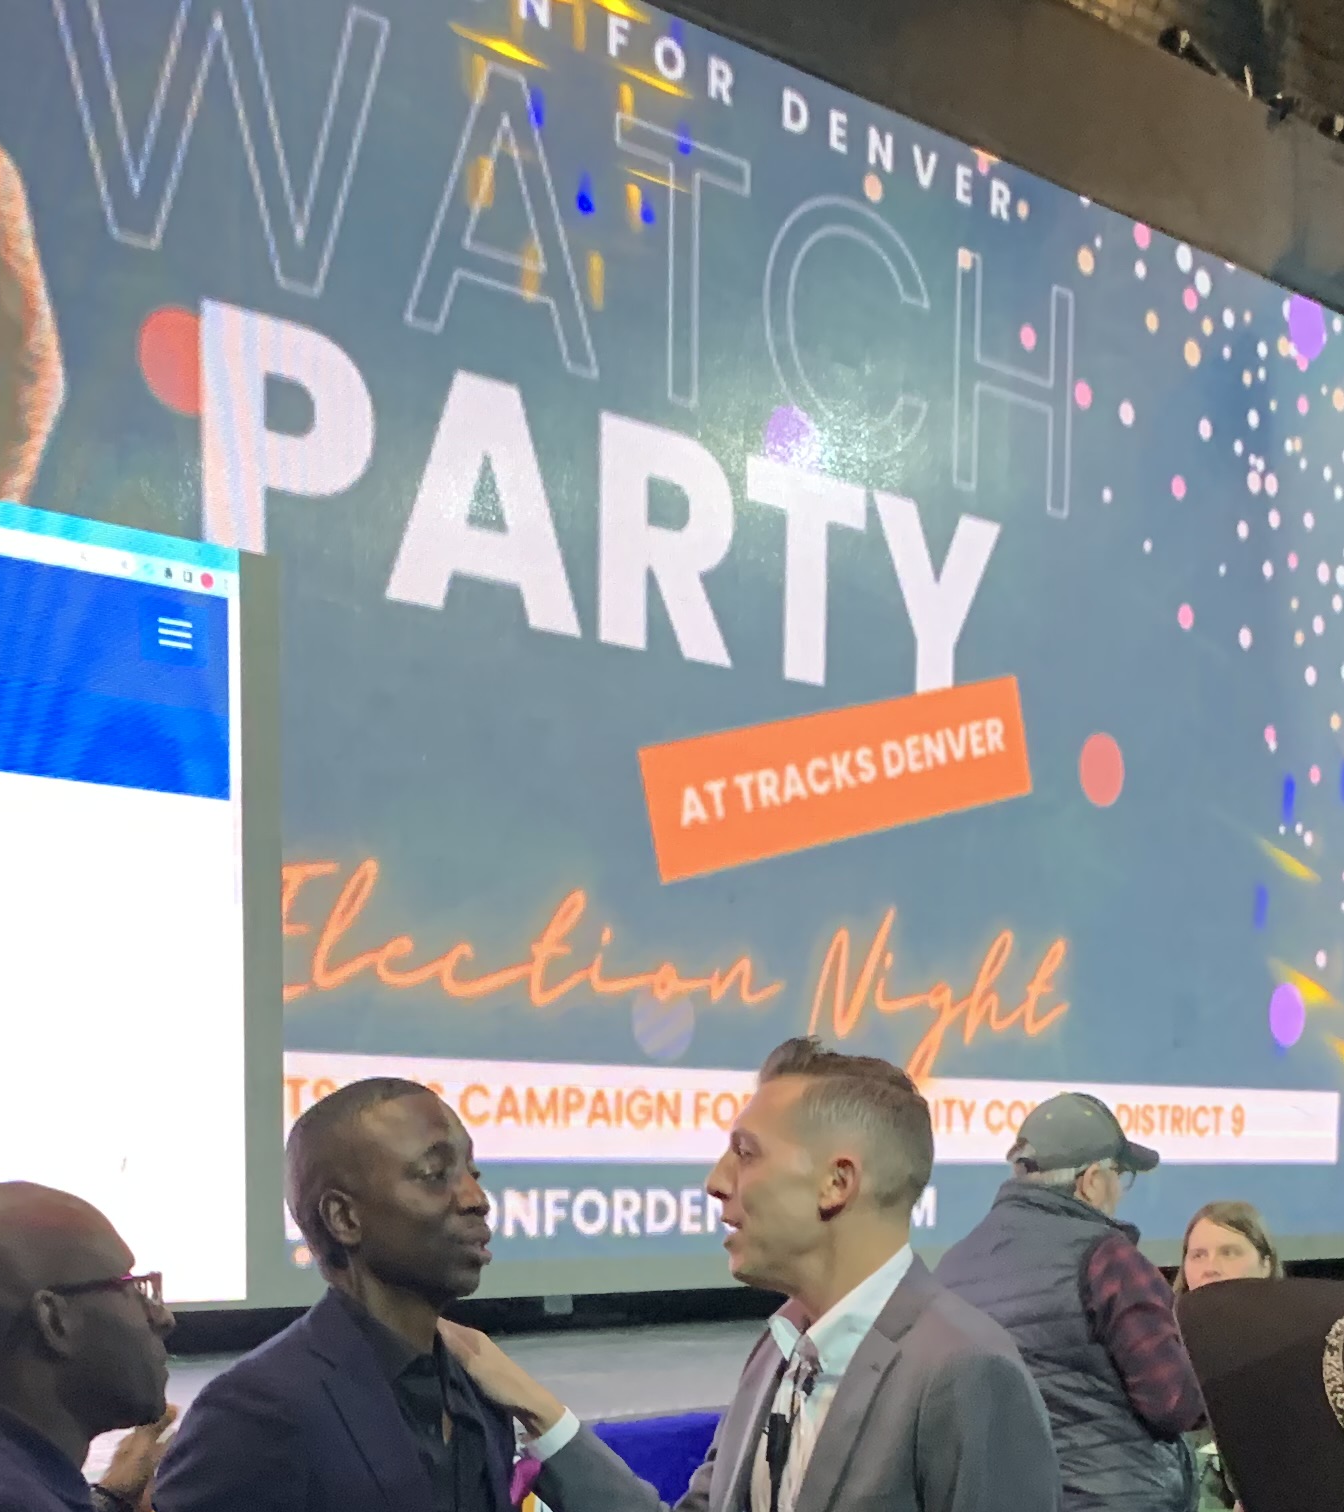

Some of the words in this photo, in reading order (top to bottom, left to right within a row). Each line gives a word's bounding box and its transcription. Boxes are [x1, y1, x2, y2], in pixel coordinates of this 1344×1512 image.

[607, 17, 735, 108] FOR
[781, 87, 1014, 224] DENVER
[53, 0, 1076, 520] WATCH
[197, 298, 1002, 694] PARTY
[678, 778, 726, 829] AT
[733, 747, 879, 818] TRACKS
[882, 716, 1007, 783] DENVER
[282, 856, 784, 1006] Election
[809, 905, 1072, 1086] Night
[459, 1082, 681, 1131] CAMPAIGN
[934, 1098, 977, 1135] ITY
[1115, 1103, 1225, 1137] DISTRICT
[1231, 1103, 1246, 1137] 9
